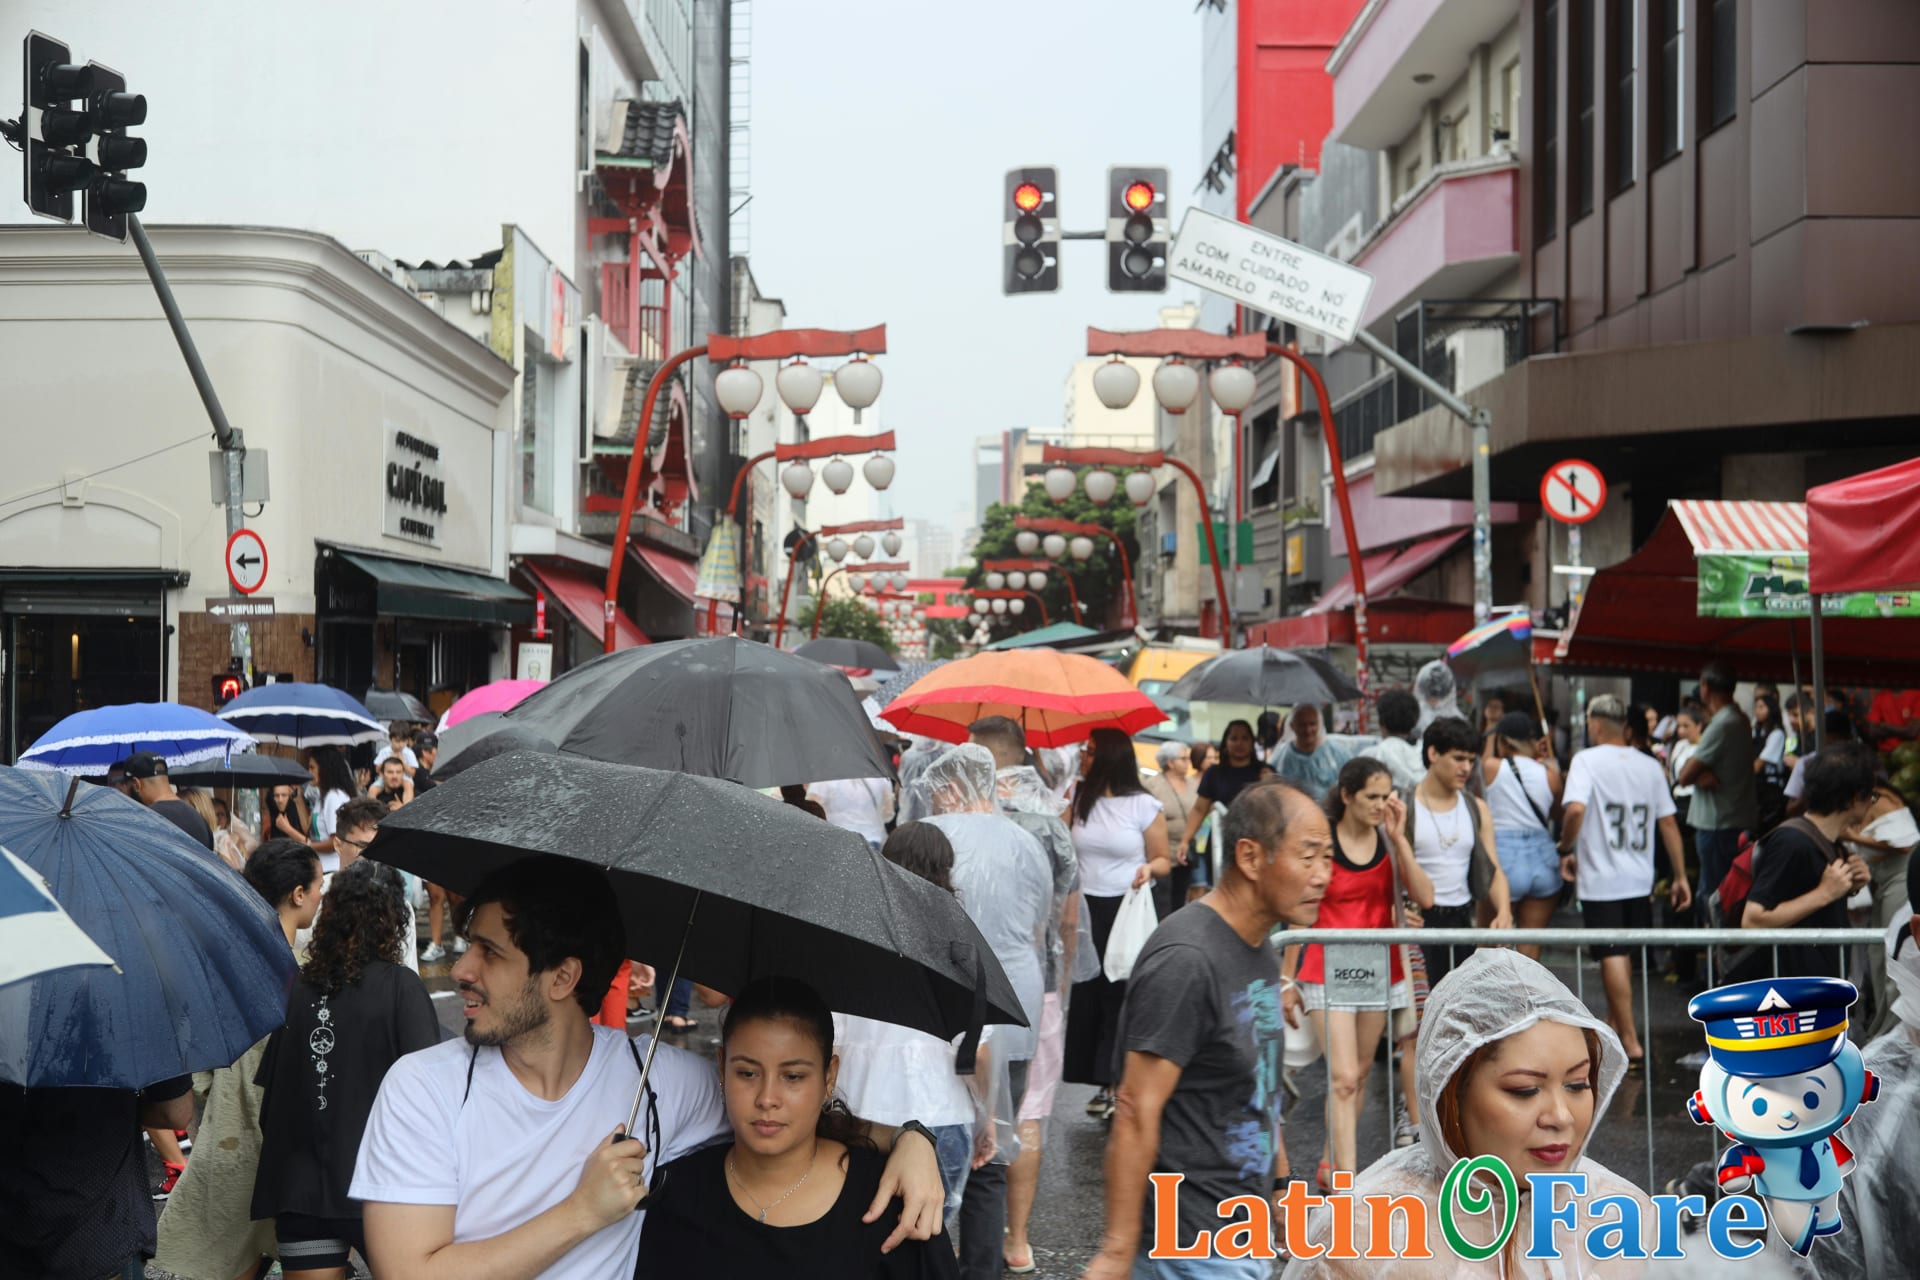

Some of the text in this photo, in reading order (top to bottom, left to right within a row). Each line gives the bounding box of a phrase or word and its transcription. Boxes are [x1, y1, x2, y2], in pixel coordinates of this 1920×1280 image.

[1195, 241, 1344, 306] COM CUIDADO NO
[1251, 241, 1302, 270] ENTRE
[1178, 257, 1349, 330] AMARELO PISCANTE
[227, 604, 273, 615] TEMPLO LOHAN
[1606, 803, 1648, 851] 33
[1334, 968, 1375, 980] RECON
